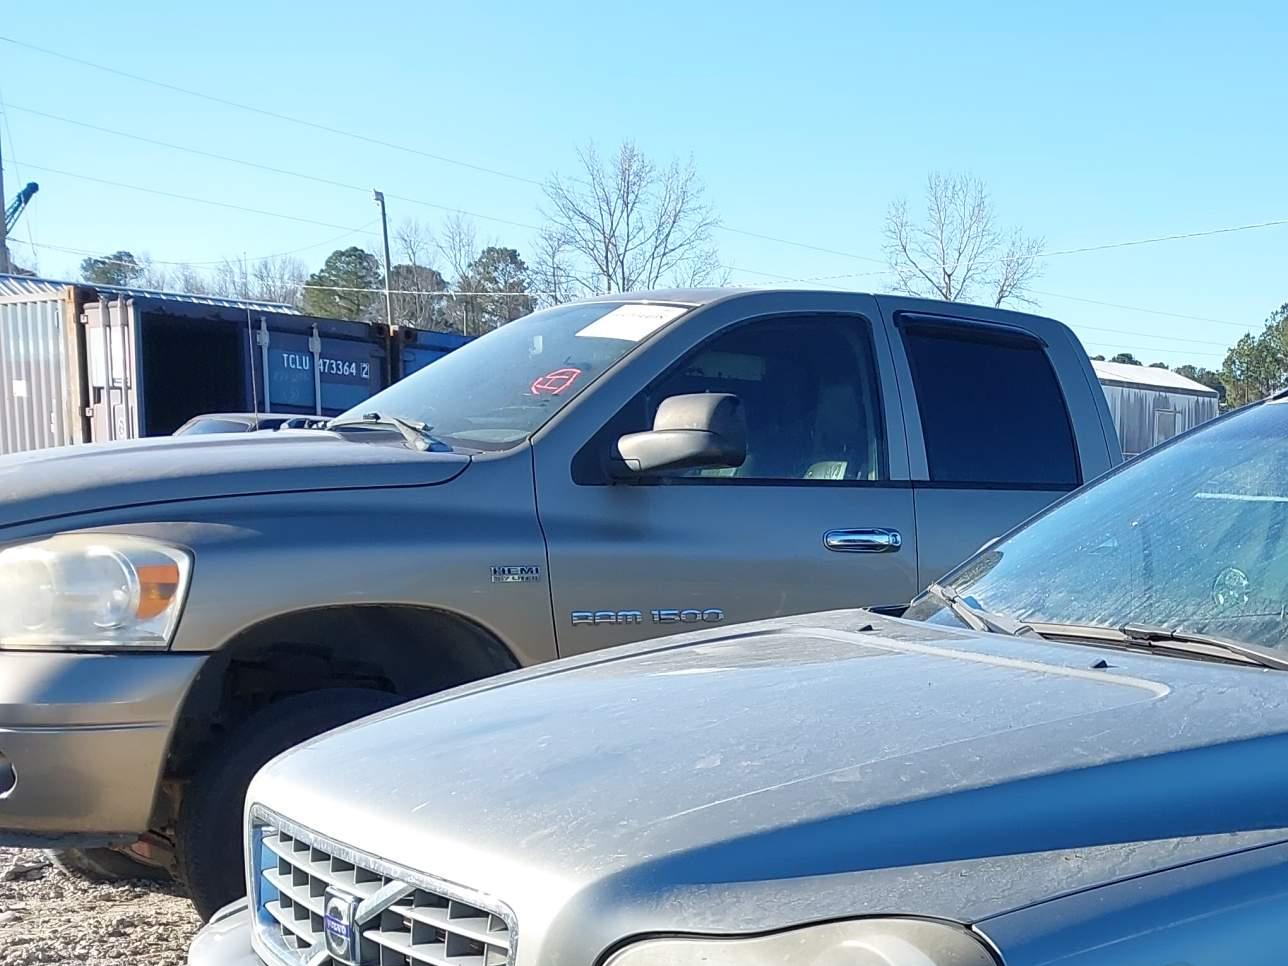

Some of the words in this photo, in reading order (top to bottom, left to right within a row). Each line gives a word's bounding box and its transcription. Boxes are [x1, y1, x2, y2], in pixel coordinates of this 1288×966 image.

[282, 353, 309, 370] TCLU
[491, 566, 540, 575] HEMI
[571, 610, 643, 626] RAM
[651, 608, 725, 625] 1500
